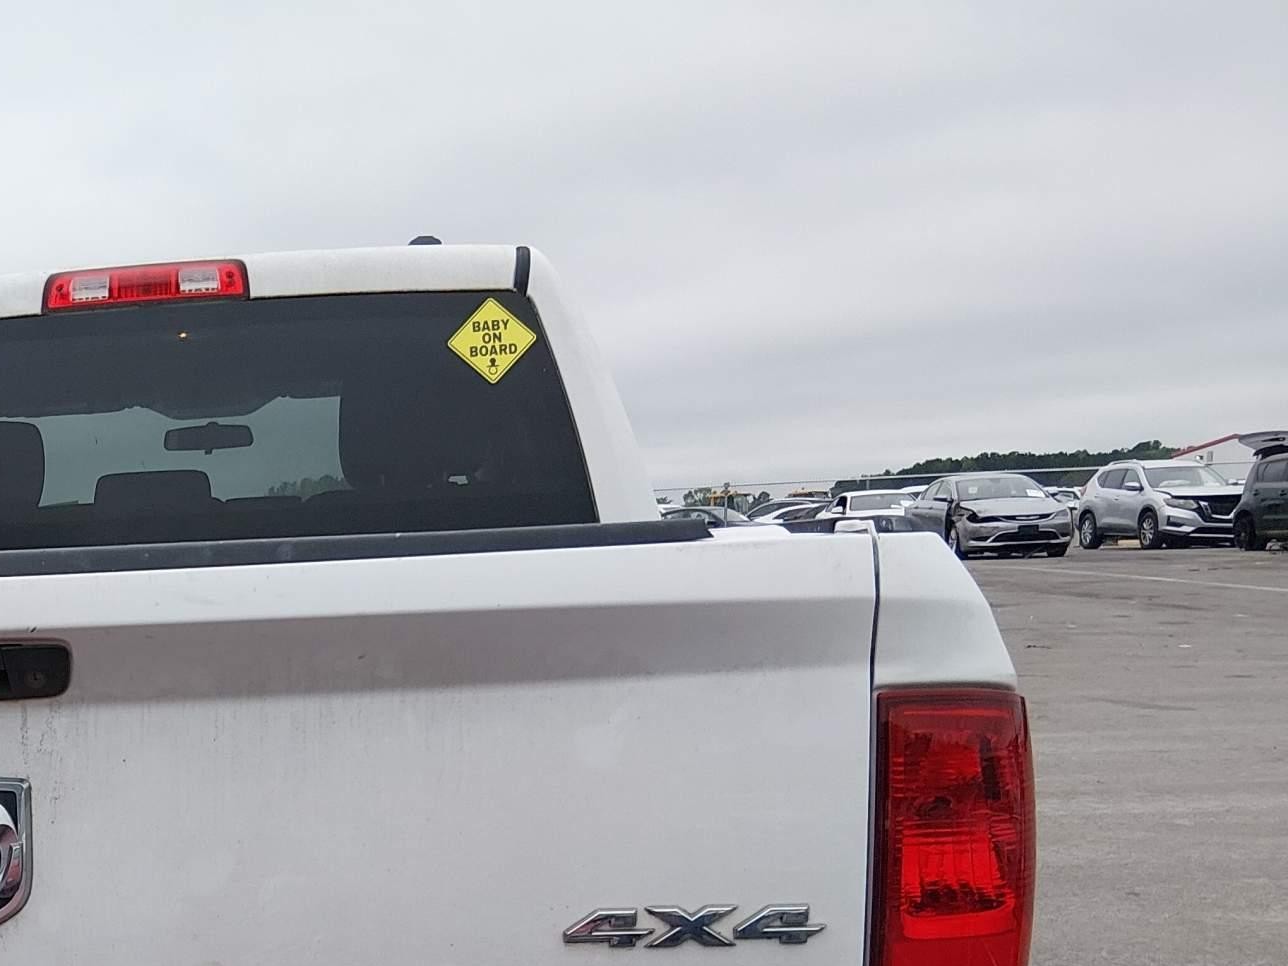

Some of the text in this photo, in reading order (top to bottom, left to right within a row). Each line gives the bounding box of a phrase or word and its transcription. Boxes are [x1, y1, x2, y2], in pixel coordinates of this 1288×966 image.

[472, 319, 510, 333] BABY
[481, 332, 502, 344] ON
[469, 343, 518, 357] BOARD
[563, 903, 826, 948] 4X4
